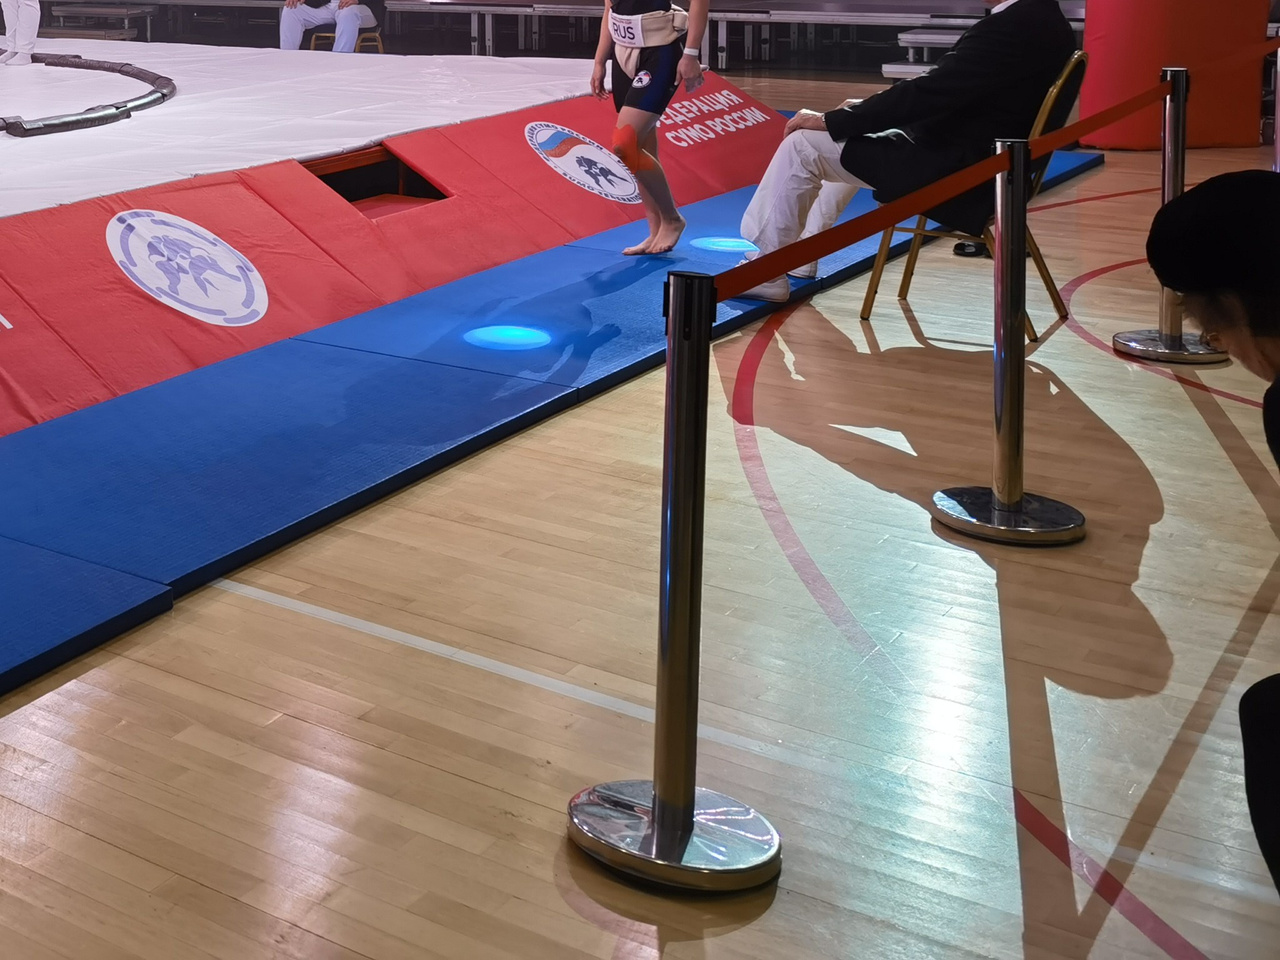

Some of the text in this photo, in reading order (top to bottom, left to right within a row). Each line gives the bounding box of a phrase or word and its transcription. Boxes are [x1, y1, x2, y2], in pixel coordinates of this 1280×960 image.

[612, 22, 636, 40] RUS
[656, 89, 745, 127] ЕДЕРАЦИЯ
[665, 106, 771, 147] СУМО РОССИИ
